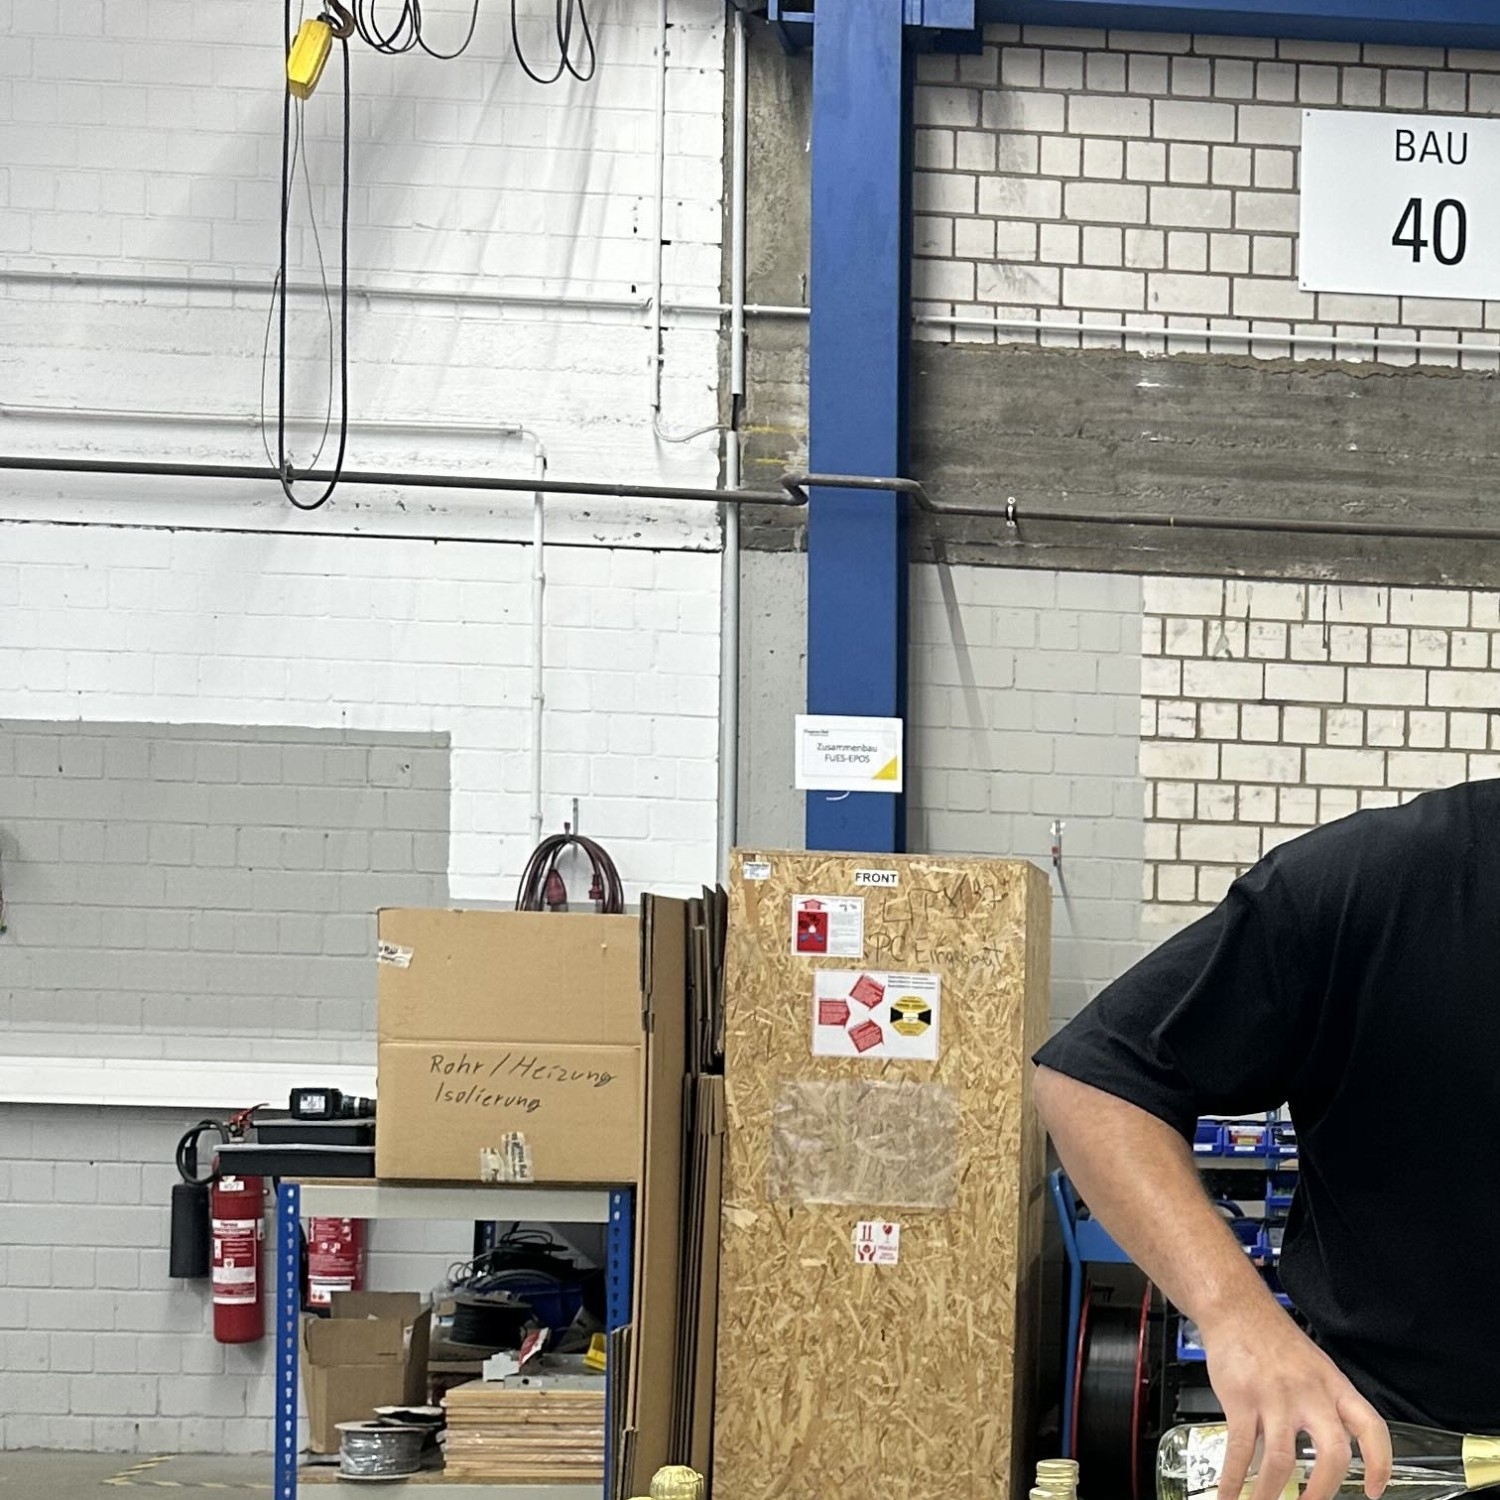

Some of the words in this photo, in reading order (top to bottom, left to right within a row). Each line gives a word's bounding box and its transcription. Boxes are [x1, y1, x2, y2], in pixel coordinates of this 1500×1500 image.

[1395, 129, 1468, 165] BAU
[1392, 197, 1467, 266] 40
[816, 742, 878, 753] Zusammenbau
[855, 872, 898, 884] FRONT
[434, 1082, 543, 1113] Isolierung
